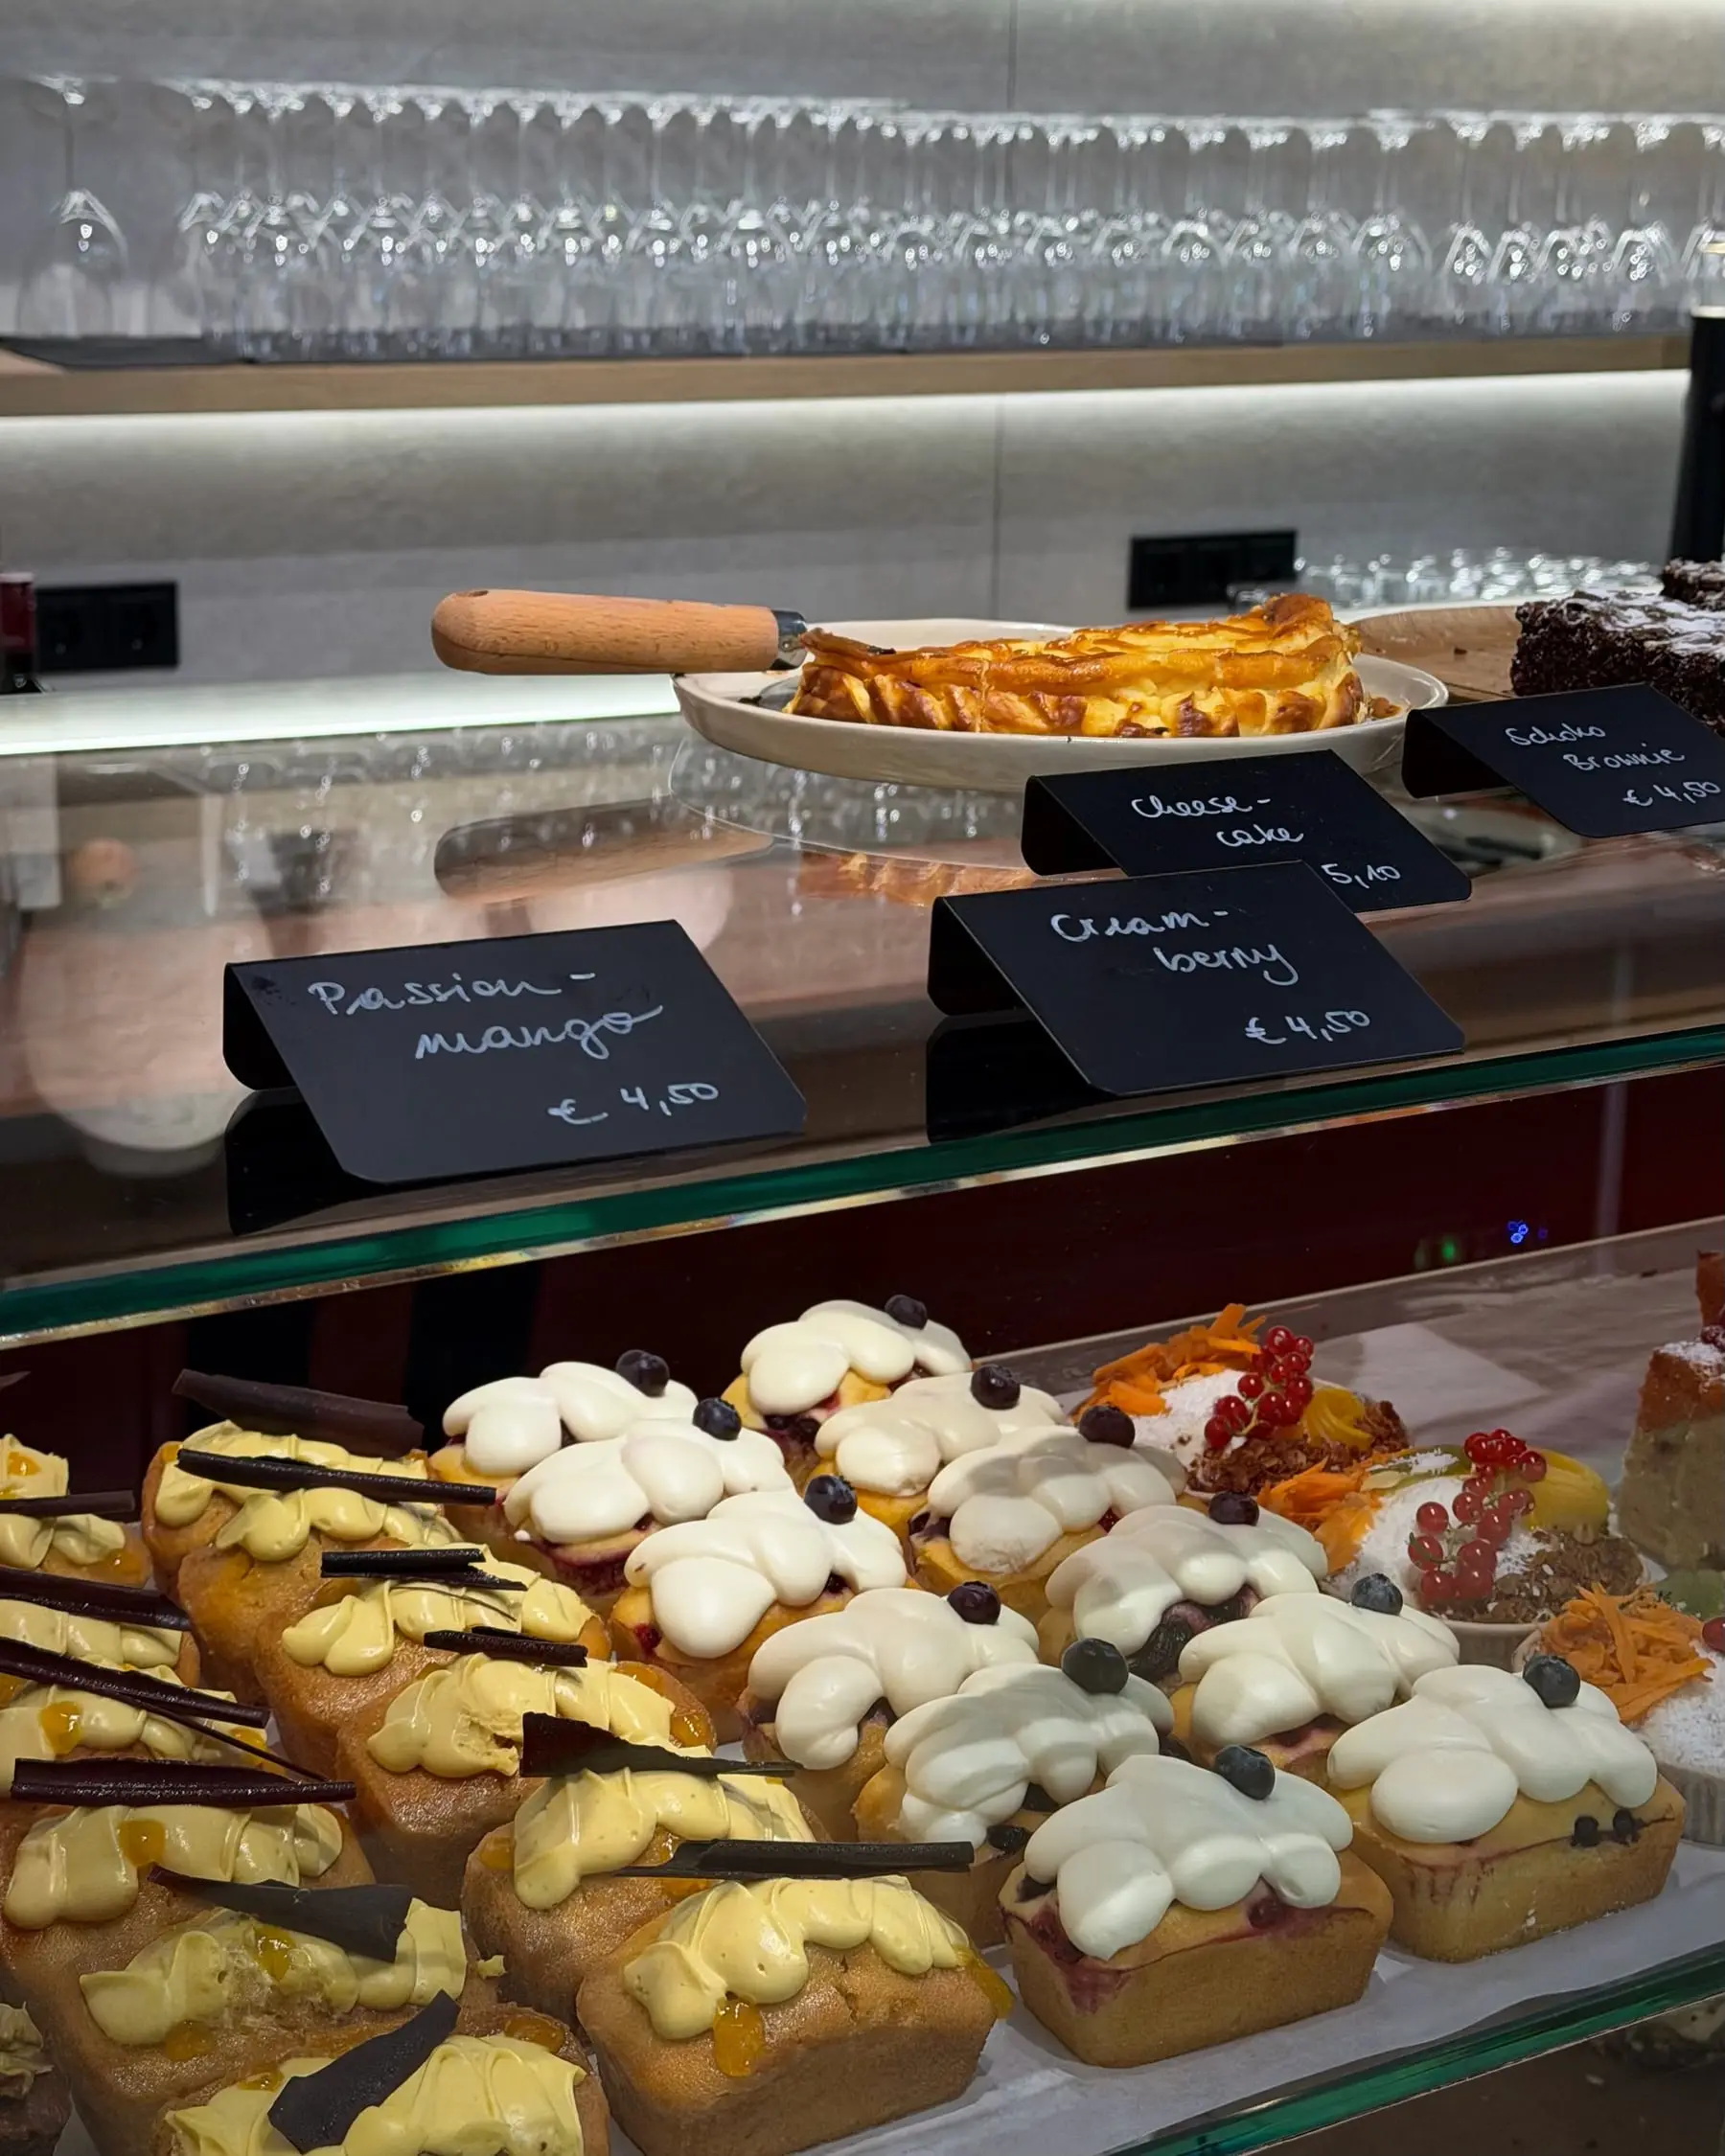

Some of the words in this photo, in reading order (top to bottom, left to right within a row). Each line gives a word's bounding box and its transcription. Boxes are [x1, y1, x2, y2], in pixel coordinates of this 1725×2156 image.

[1505, 722, 1606, 746] Schoko
[1562, 743, 1686, 771] Brownie
[1653, 780, 1722, 805] 4,50
[1216, 823, 1304, 848] cake
[1321, 862, 1401, 889] 5,10
[1153, 943, 1300, 986] berry
[415, 1004, 663, 1060] mango
[620, 1081, 719, 1115] 4,50
